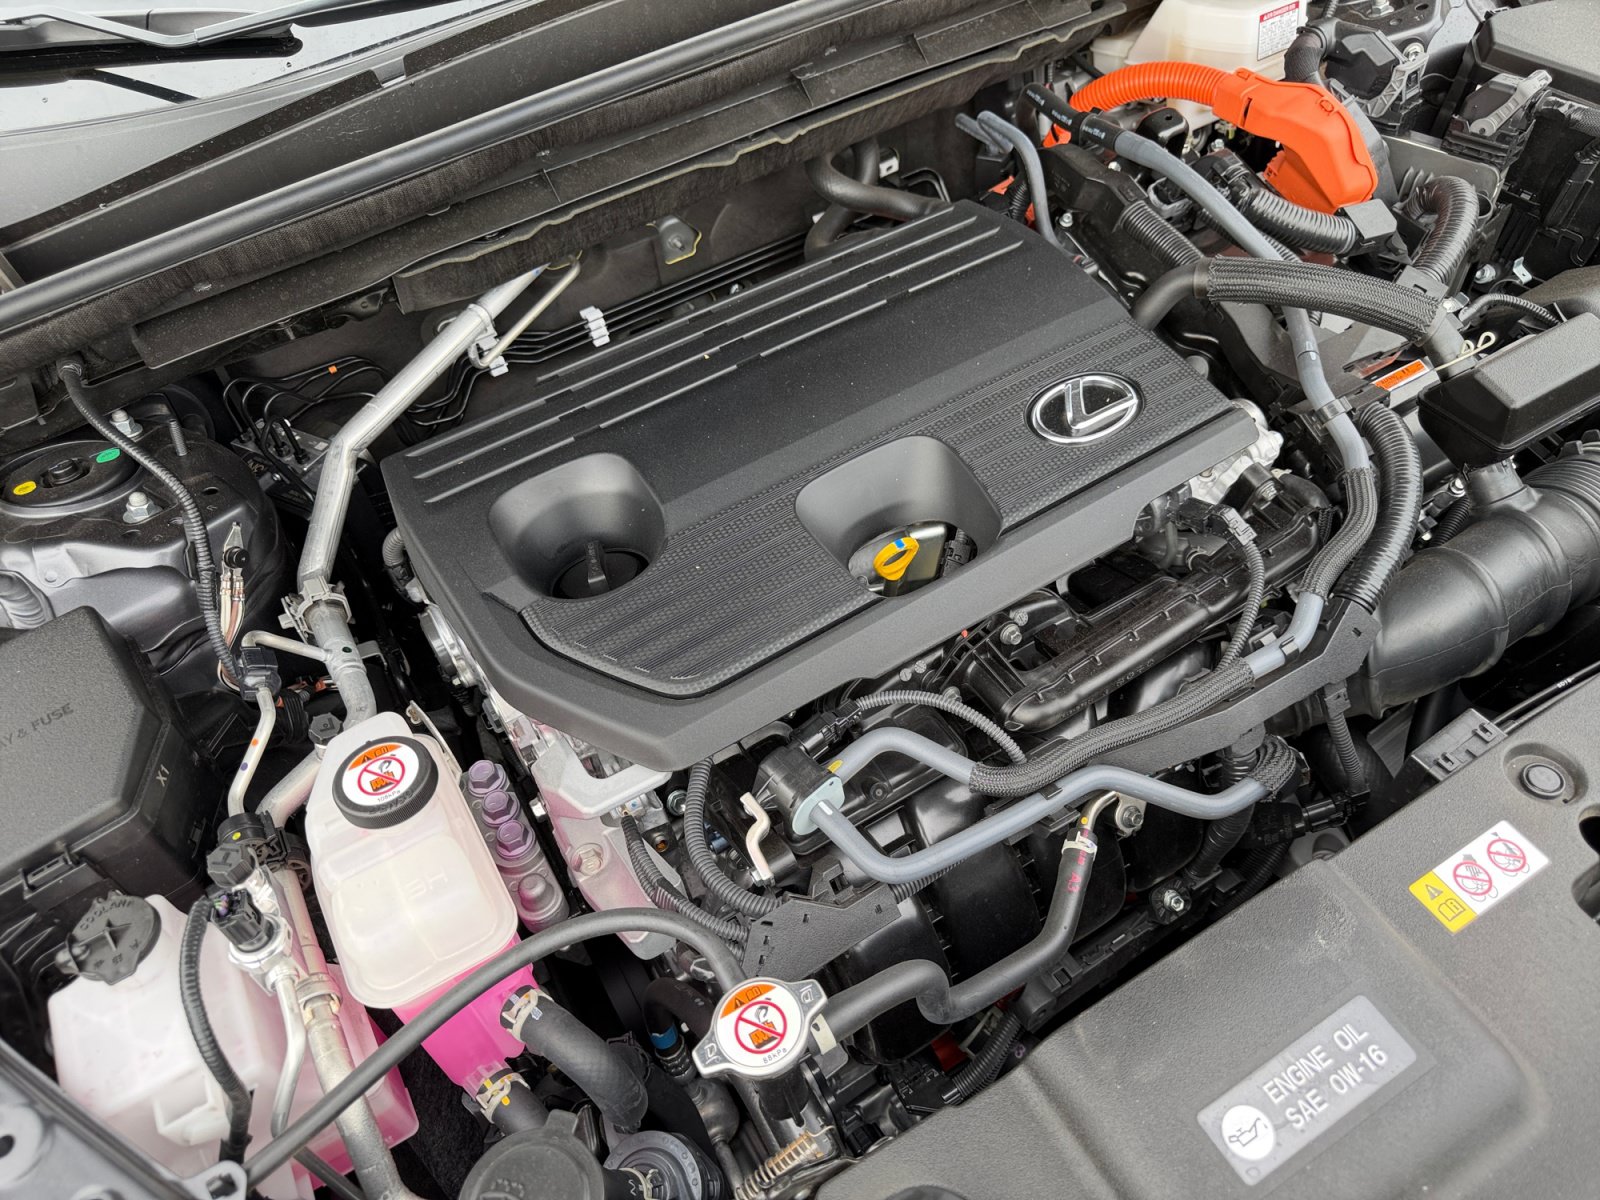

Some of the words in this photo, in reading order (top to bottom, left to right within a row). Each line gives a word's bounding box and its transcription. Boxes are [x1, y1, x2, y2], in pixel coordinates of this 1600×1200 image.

[17, 727, 29, 739] &
[31, 702, 74, 731] FUSE
[155, 763, 170, 787] X1
[79, 899, 134, 930] COOLANT
[762, 1047, 788, 1065] 88kPa
[1262, 1044, 1334, 1104] ENGINE
[1333, 1023, 1370, 1052] OIL
[1285, 1088, 1330, 1129] SAE
[1328, 1044, 1388, 1095] 0W-16
